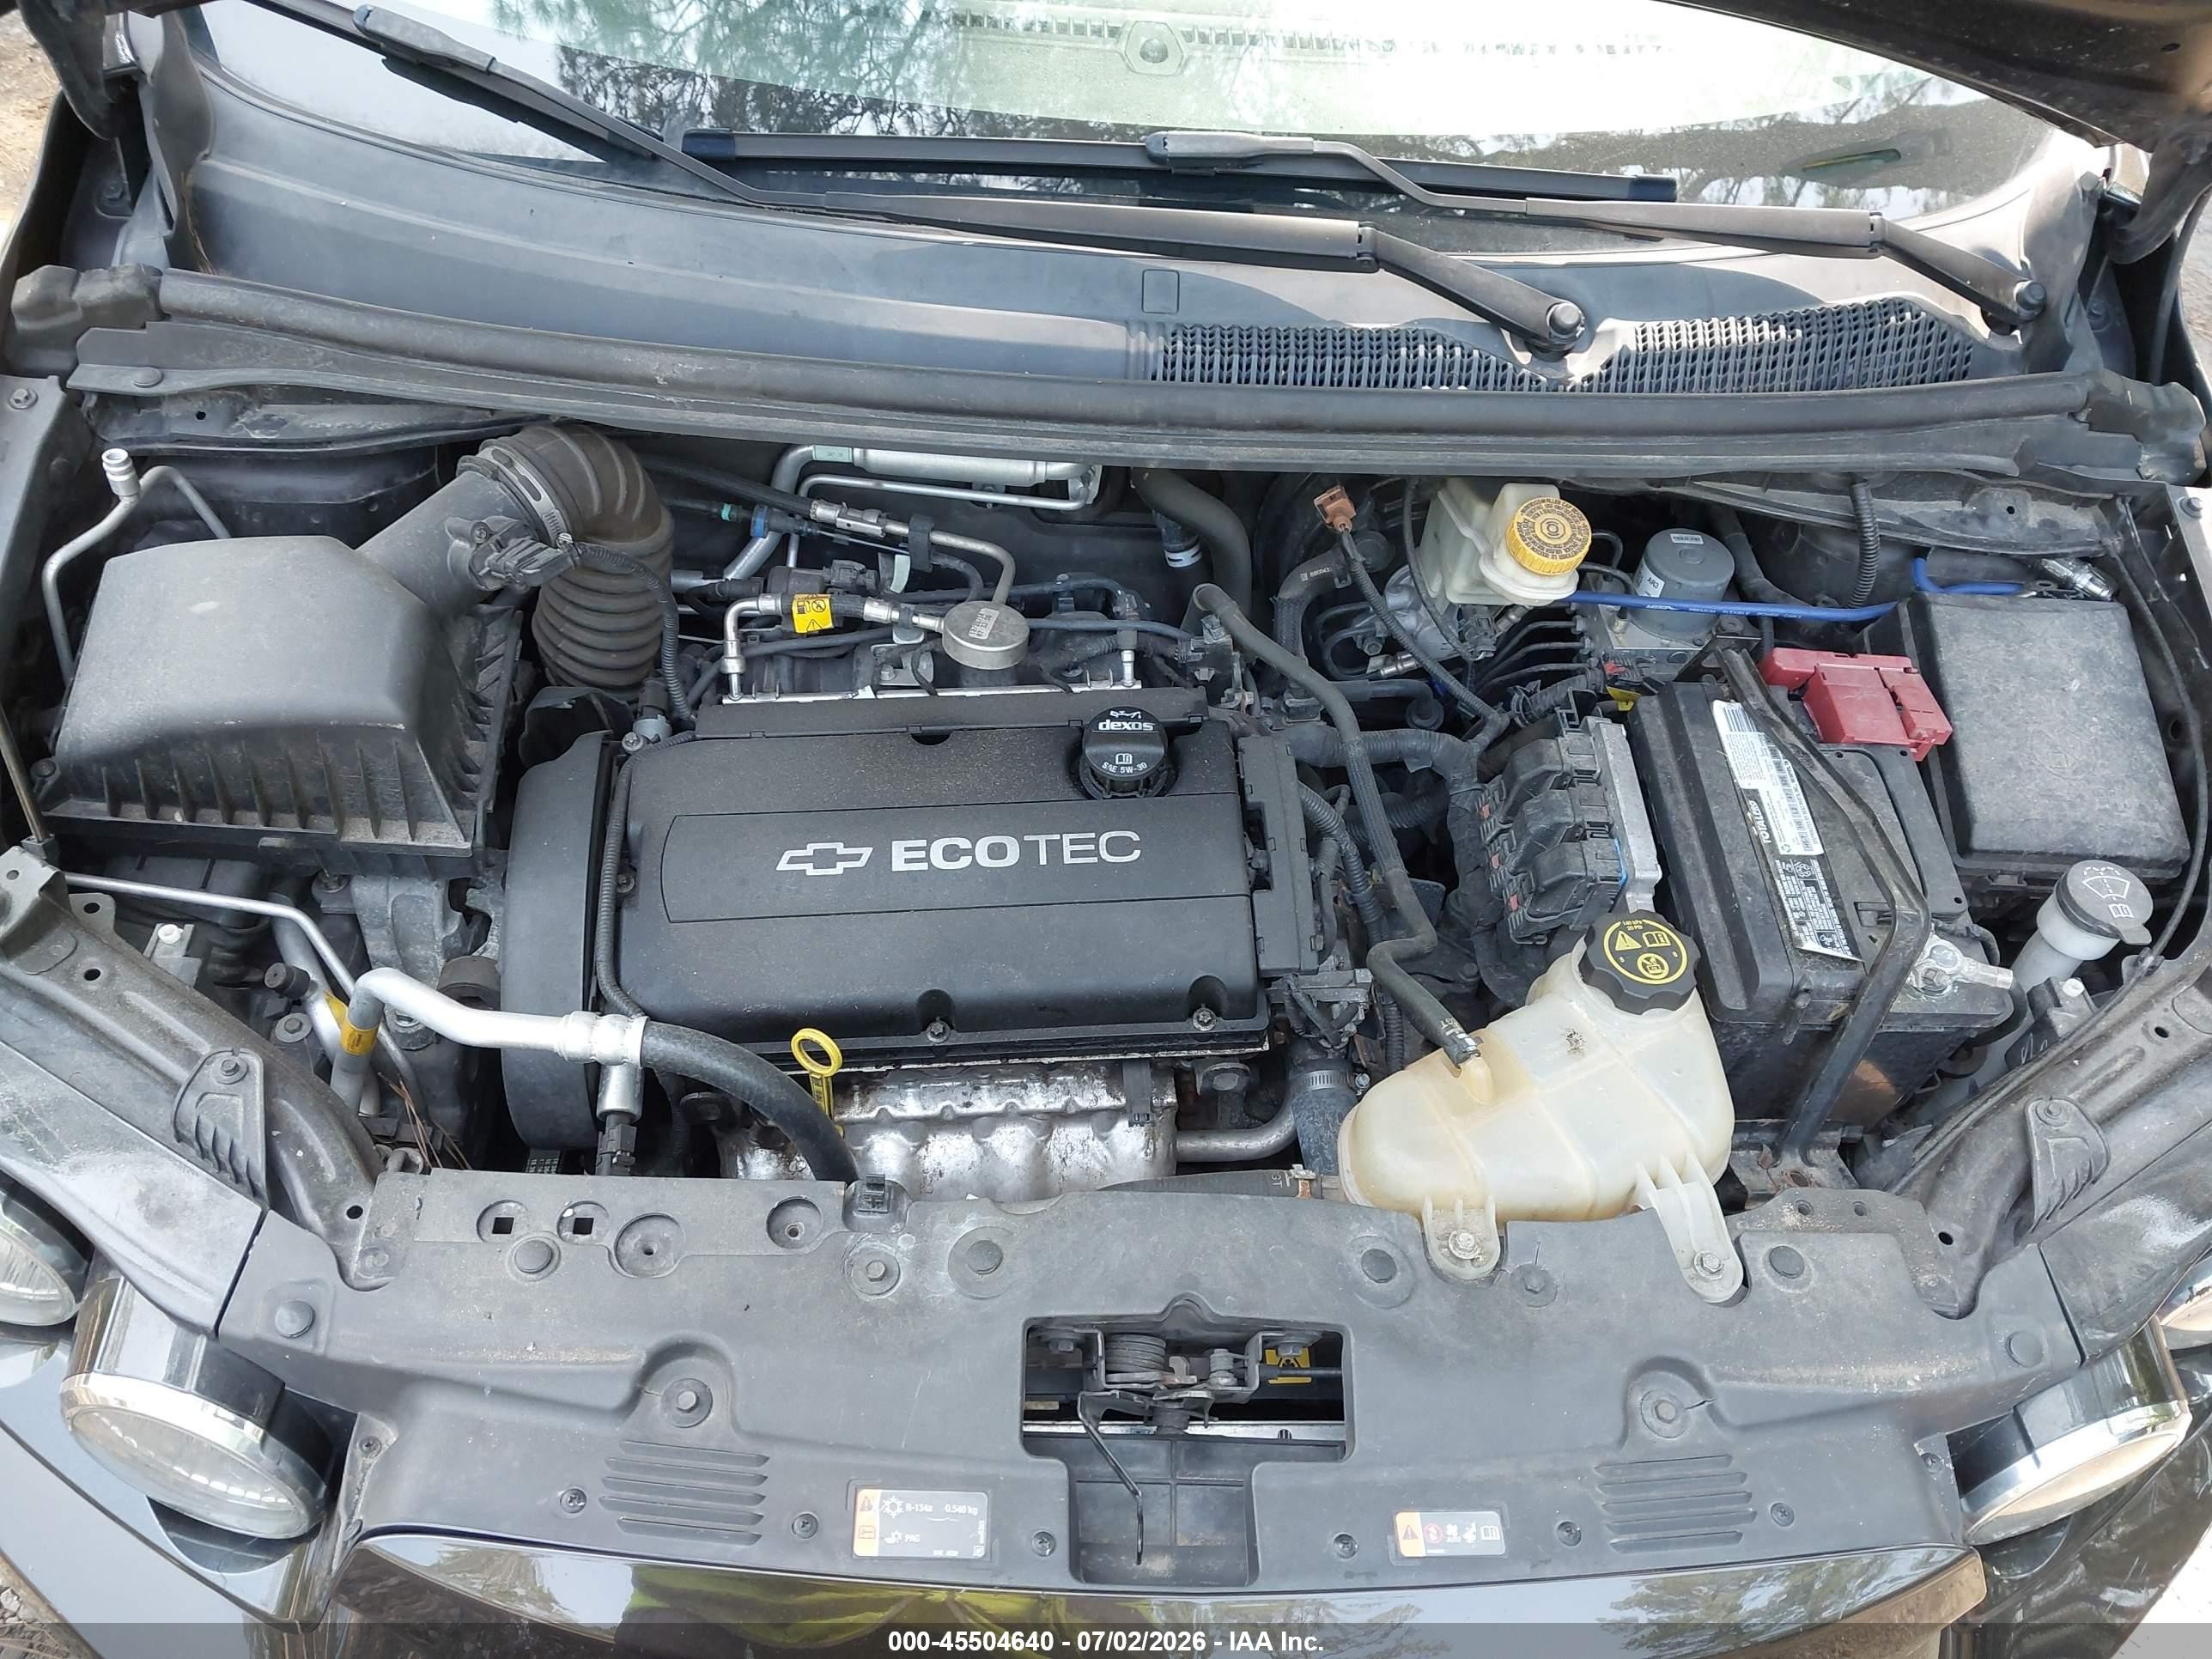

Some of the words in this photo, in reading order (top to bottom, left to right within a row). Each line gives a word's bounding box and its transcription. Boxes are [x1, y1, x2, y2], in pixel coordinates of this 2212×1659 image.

[1097, 719, 1157, 731] dexos
[1102, 762, 1117, 773] SAE
[1119, 762, 1148, 774] 5W-30
[891, 830, 1141, 872] ECOTEC
